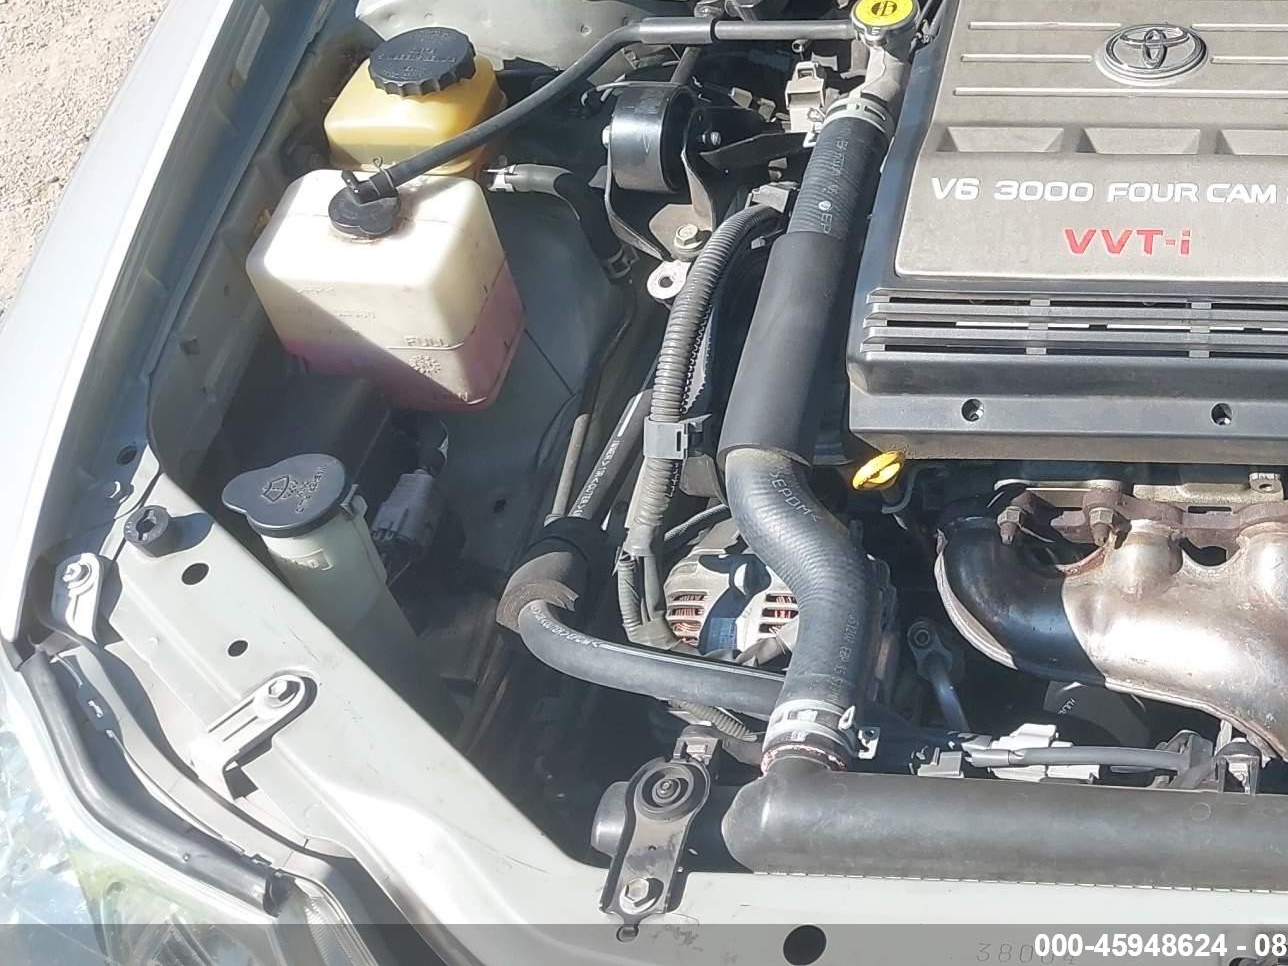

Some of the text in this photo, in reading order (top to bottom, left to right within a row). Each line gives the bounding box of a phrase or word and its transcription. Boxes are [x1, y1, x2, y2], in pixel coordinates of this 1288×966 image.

[931, 177, 980, 201] V6
[994, 179, 1095, 203] 3000
[1106, 181, 1199, 203] FOUR
[1206, 183, 1277, 204] CAM
[1063, 227, 1192, 257] VVT-i
[404, 336, 449, 347] FULL
